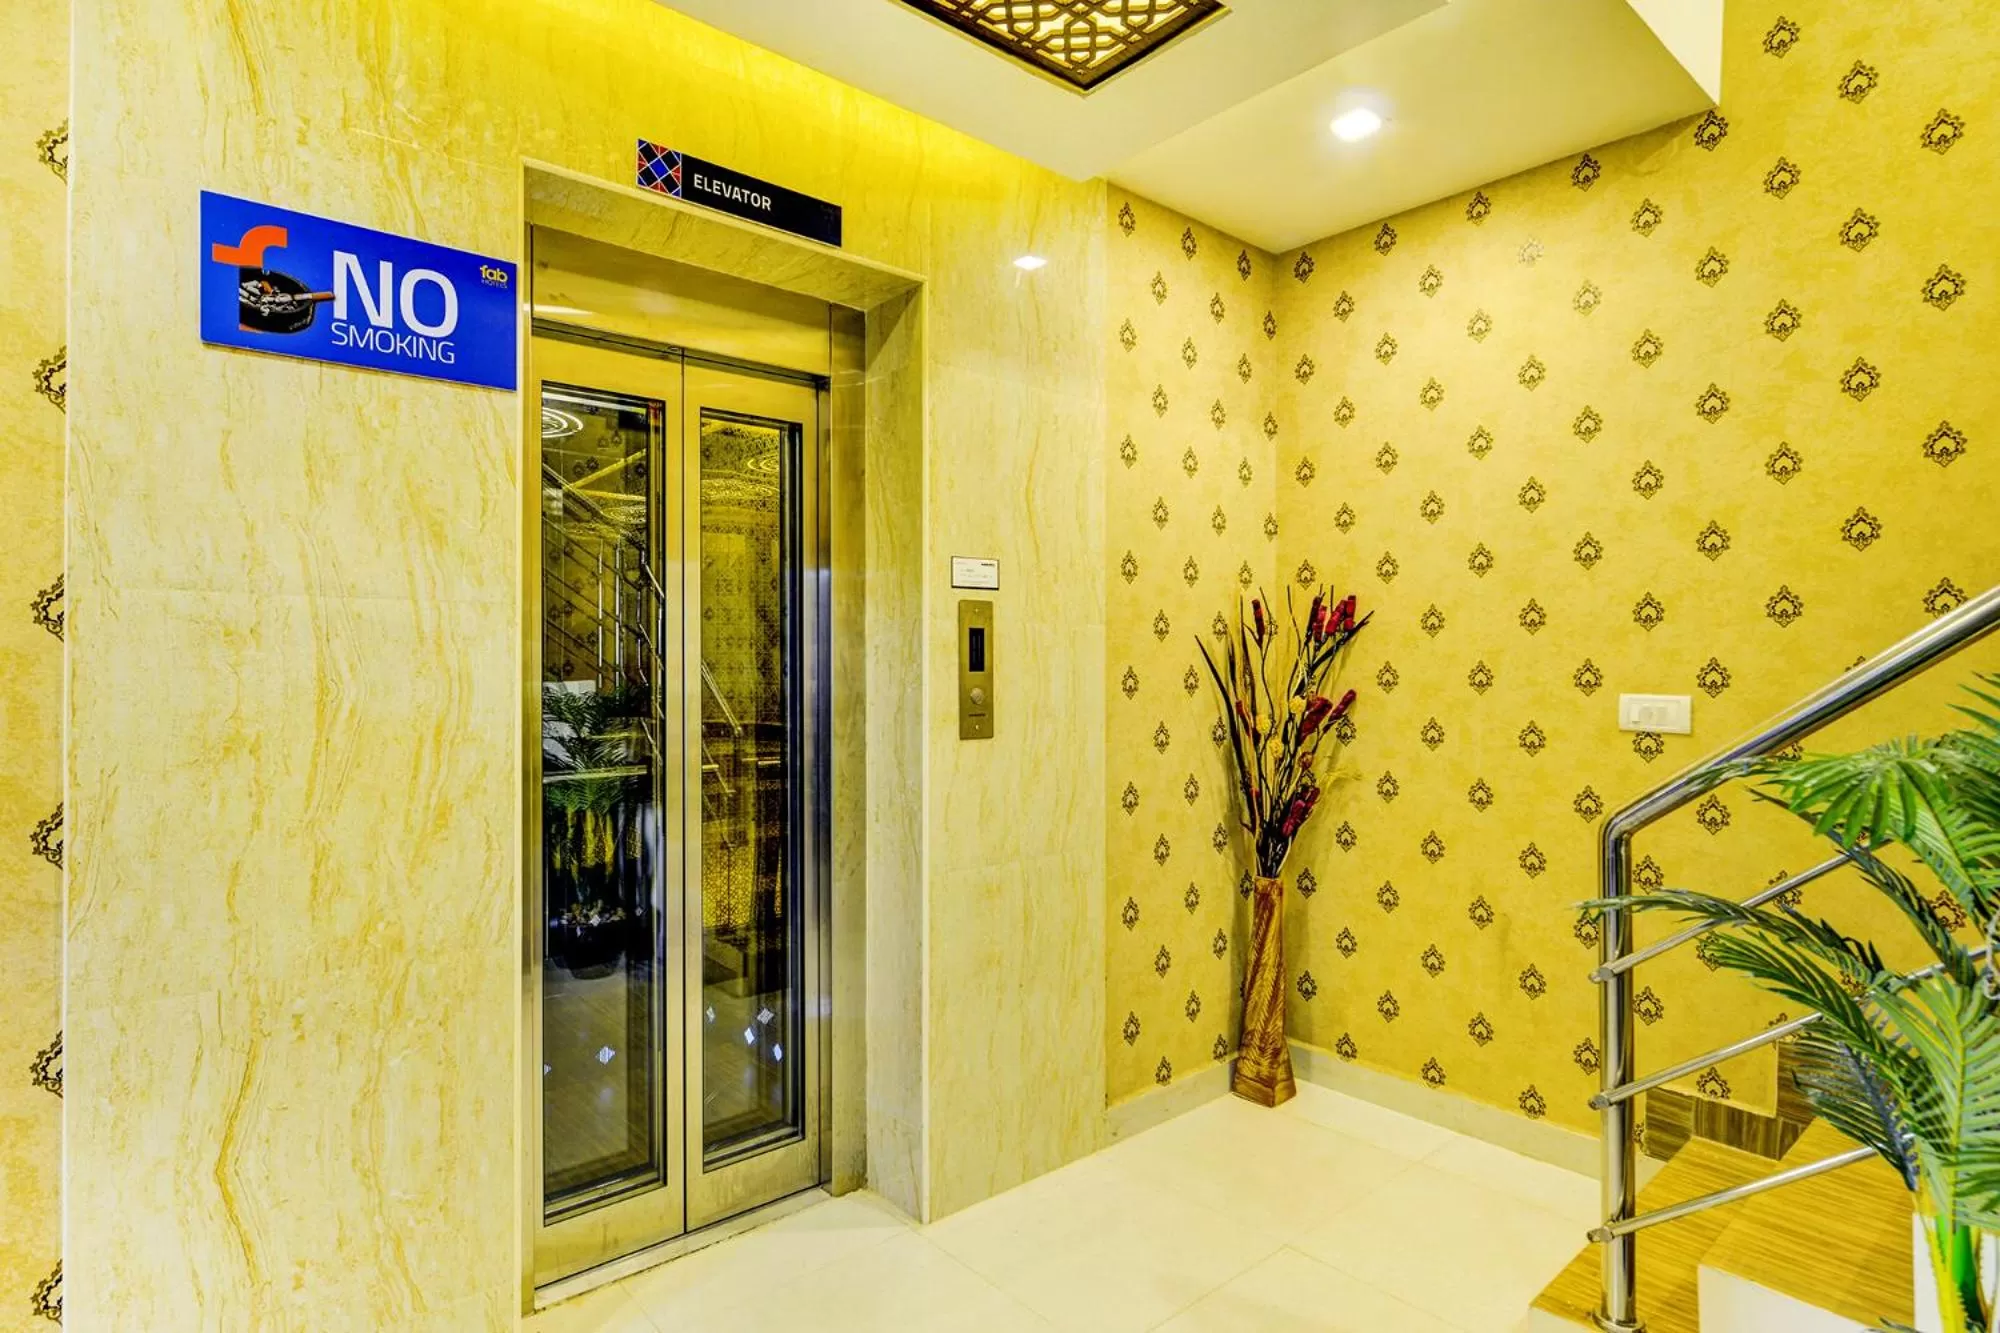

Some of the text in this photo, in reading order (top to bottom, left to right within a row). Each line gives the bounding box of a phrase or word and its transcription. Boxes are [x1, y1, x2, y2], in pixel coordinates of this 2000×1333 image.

[693, 172, 772, 212] ELEVATOR
[480, 264, 508, 282] fab
[333, 250, 458, 338] NO
[331, 321, 455, 364] SMOKING
